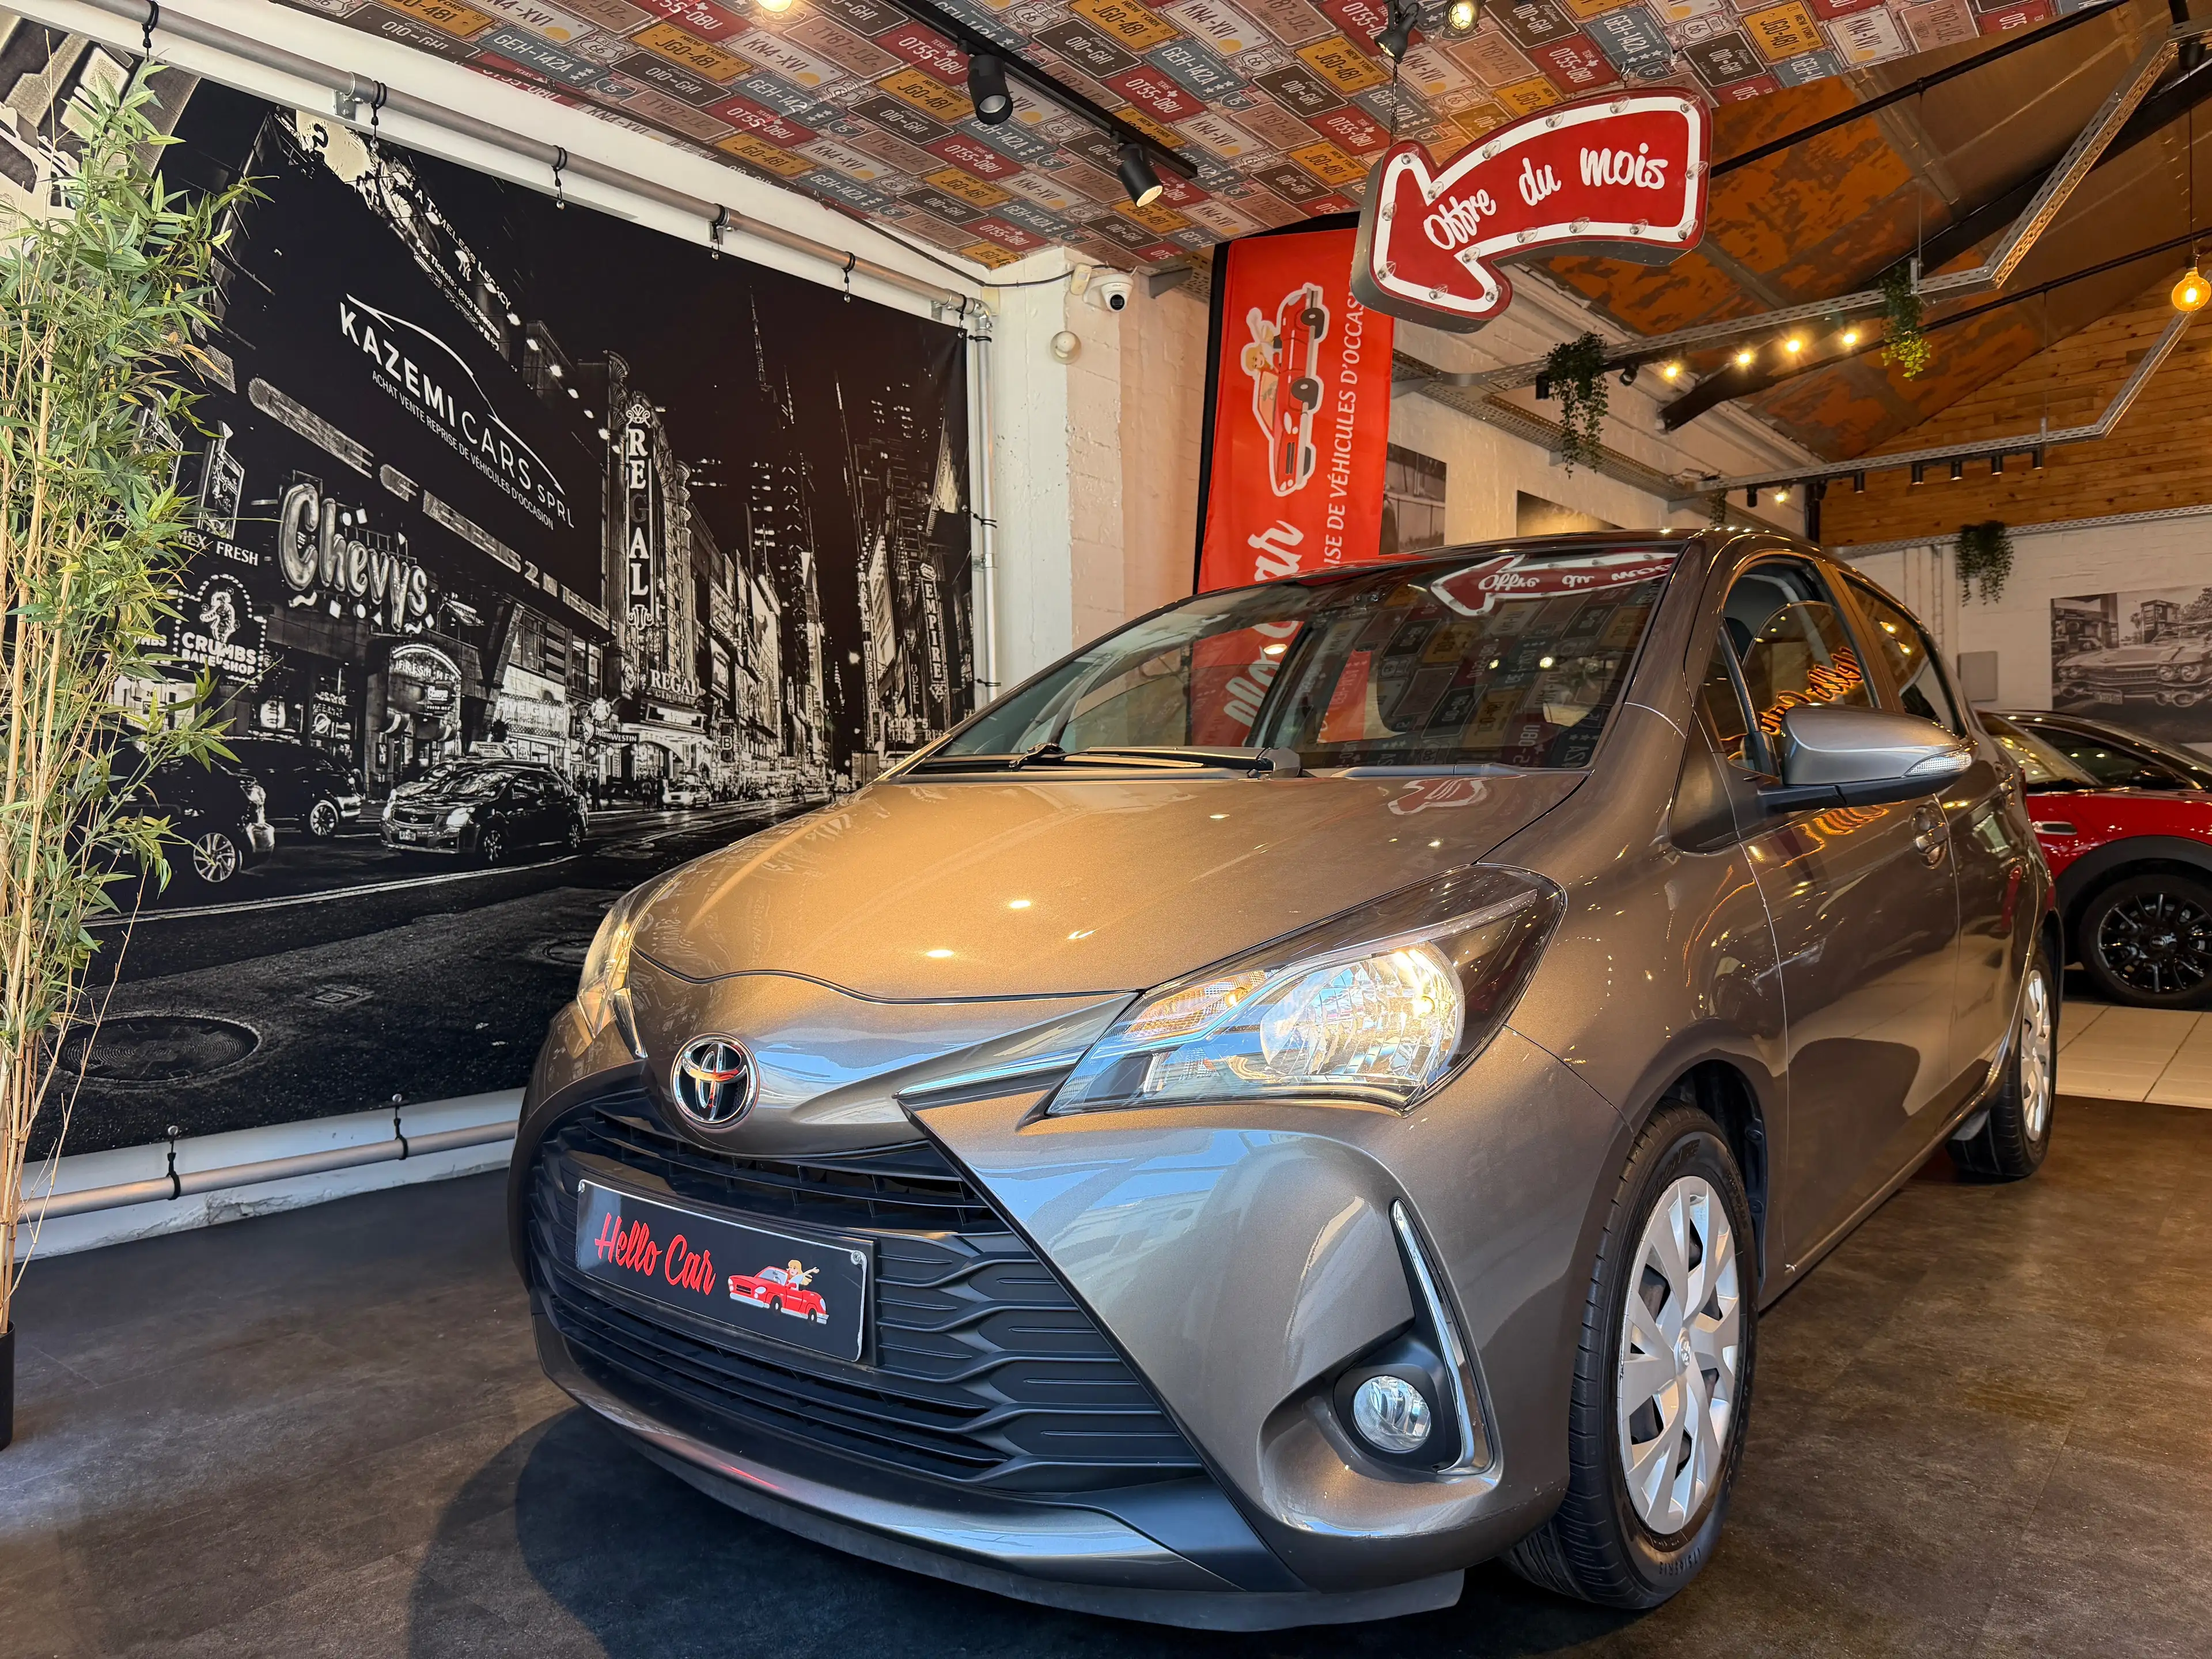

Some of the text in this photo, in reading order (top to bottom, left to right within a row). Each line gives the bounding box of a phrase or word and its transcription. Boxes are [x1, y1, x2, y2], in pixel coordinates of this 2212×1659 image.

[1024, 11, 1039, 22] 66
[1121, 0, 1162, 27] NEW YORK
[1604, 15, 1650, 55] GEH-142A
[1690, 25, 1703, 34] 66
[1794, 13, 1815, 40] NEW YORK
[493, 35, 574, 74] GEH-142A
[588, 44, 607, 54] 66
[680, 35, 730, 60] NEW YORK
[513, 68, 534, 78] TEXAS
[1161, 47, 1219, 85] GEH-142A
[1247, 56, 1266, 66] 66
[1344, 48, 1377, 73] NEW YORK
[1644, 66, 1664, 75] 15
[603, 84, 621, 93] 15
[922, 78, 964, 103] NEW YORK
[1228, 96, 1242, 105] 15
[1447, 96, 1463, 105] 66
[834, 124, 850, 132] 15
[1050, 124, 1066, 134] 66
[1041, 157, 1055, 166] 15
[415, 190, 423, 203] A
[810, 174, 868, 201] GEH-142A
[1423, 187, 1497, 251] Offre
[1518, 157, 1562, 207] du
[340, 301, 456, 428] KAZEMI
[461, 410, 532, 490] CARS
[538, 484, 575, 529] SPRL
[372, 370, 398, 400] ACHAT
[400, 395, 425, 423] VENTE
[426, 414, 459, 452] REPRISE
[459, 442, 471, 461] DE
[470, 451, 510, 495] VÉHICULES
[511, 486, 554, 531] D'OCCASION
[1328, 391, 1357, 499] VÉHICULES
[628, 429, 649, 597] REGAL
[1327, 503, 1346, 531] DE
[215, 541, 259, 566] FRESH
[279, 482, 428, 633] Chevys
[925, 584, 942, 679] EMPIRE
[181, 632, 257, 665] CRUMBS
[222, 660, 255, 675] SHOP
[611, 733, 637, 742] WESTIN
[594, 1213, 716, 1296] Hello Car
